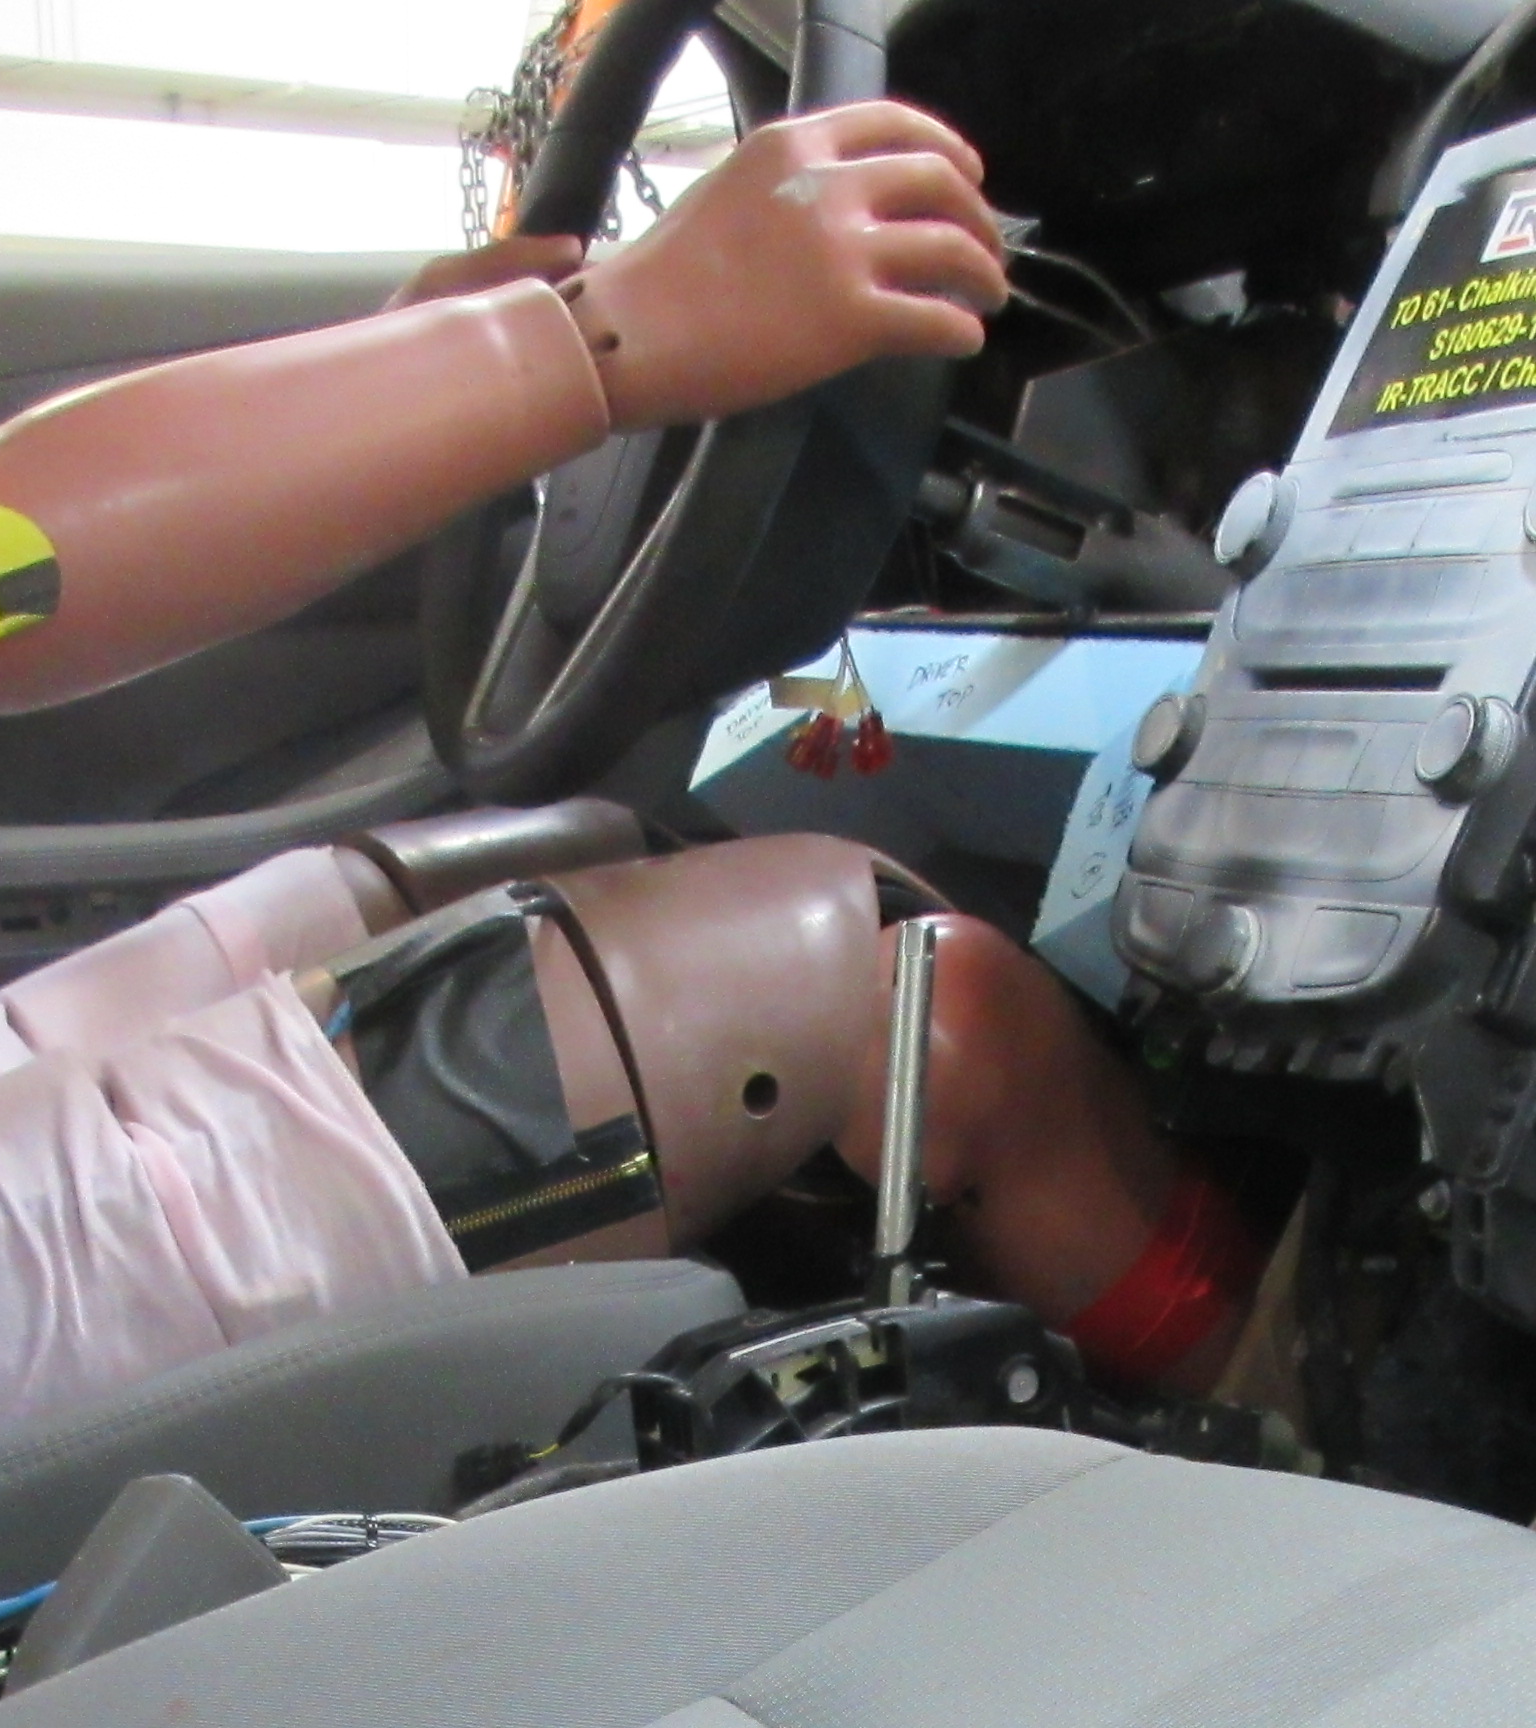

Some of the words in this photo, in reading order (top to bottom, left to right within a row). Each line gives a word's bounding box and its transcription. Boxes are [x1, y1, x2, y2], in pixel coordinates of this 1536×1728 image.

[1390, 297, 1419, 329] TO
[1421, 287, 1455, 319] 61-
[1376, 365, 1482, 412] IR-TRACC
[1482, 362, 1498, 391] /
